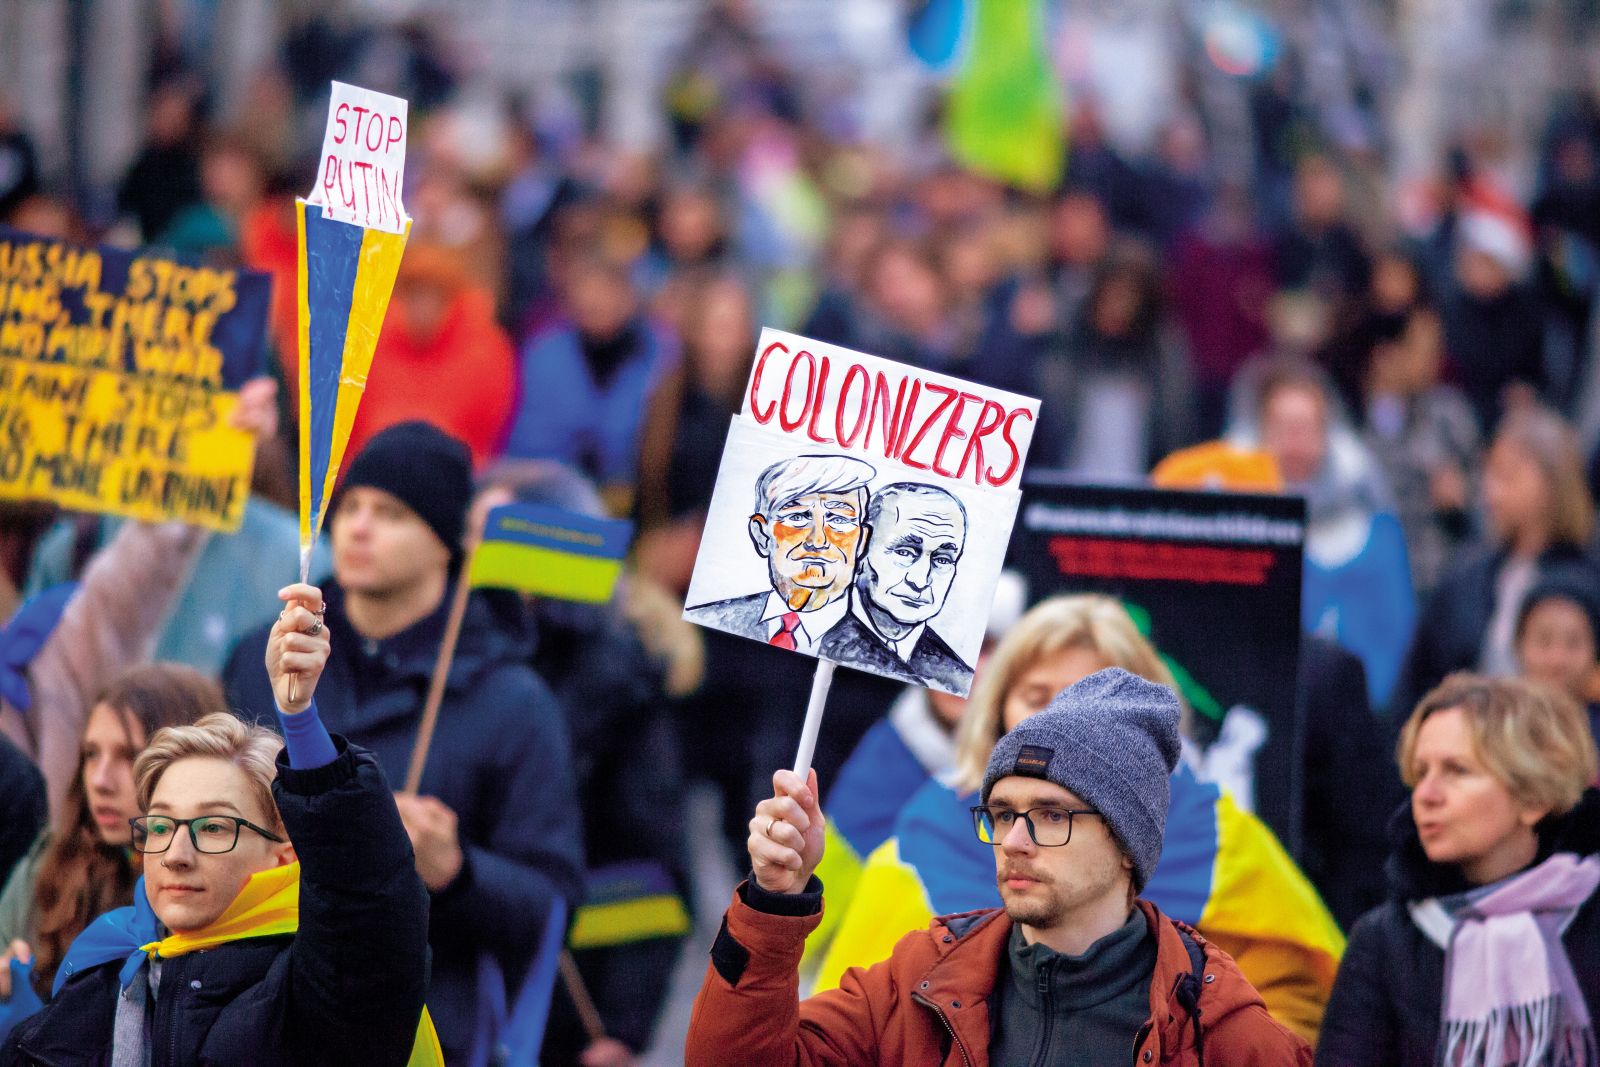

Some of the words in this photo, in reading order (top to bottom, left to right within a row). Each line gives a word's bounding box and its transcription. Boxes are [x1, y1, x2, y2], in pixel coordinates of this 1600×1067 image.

[333, 103, 403, 155] STOP
[323, 154, 401, 232] PUTIN
[126, 258, 237, 315] STOPS
[134, 344, 223, 388] WAR
[116, 376, 217, 430] STOPS
[751, 341, 1033, 488] COLONIZERS
[64, 412, 190, 463] THERE
[26, 454, 102, 497] MORE
